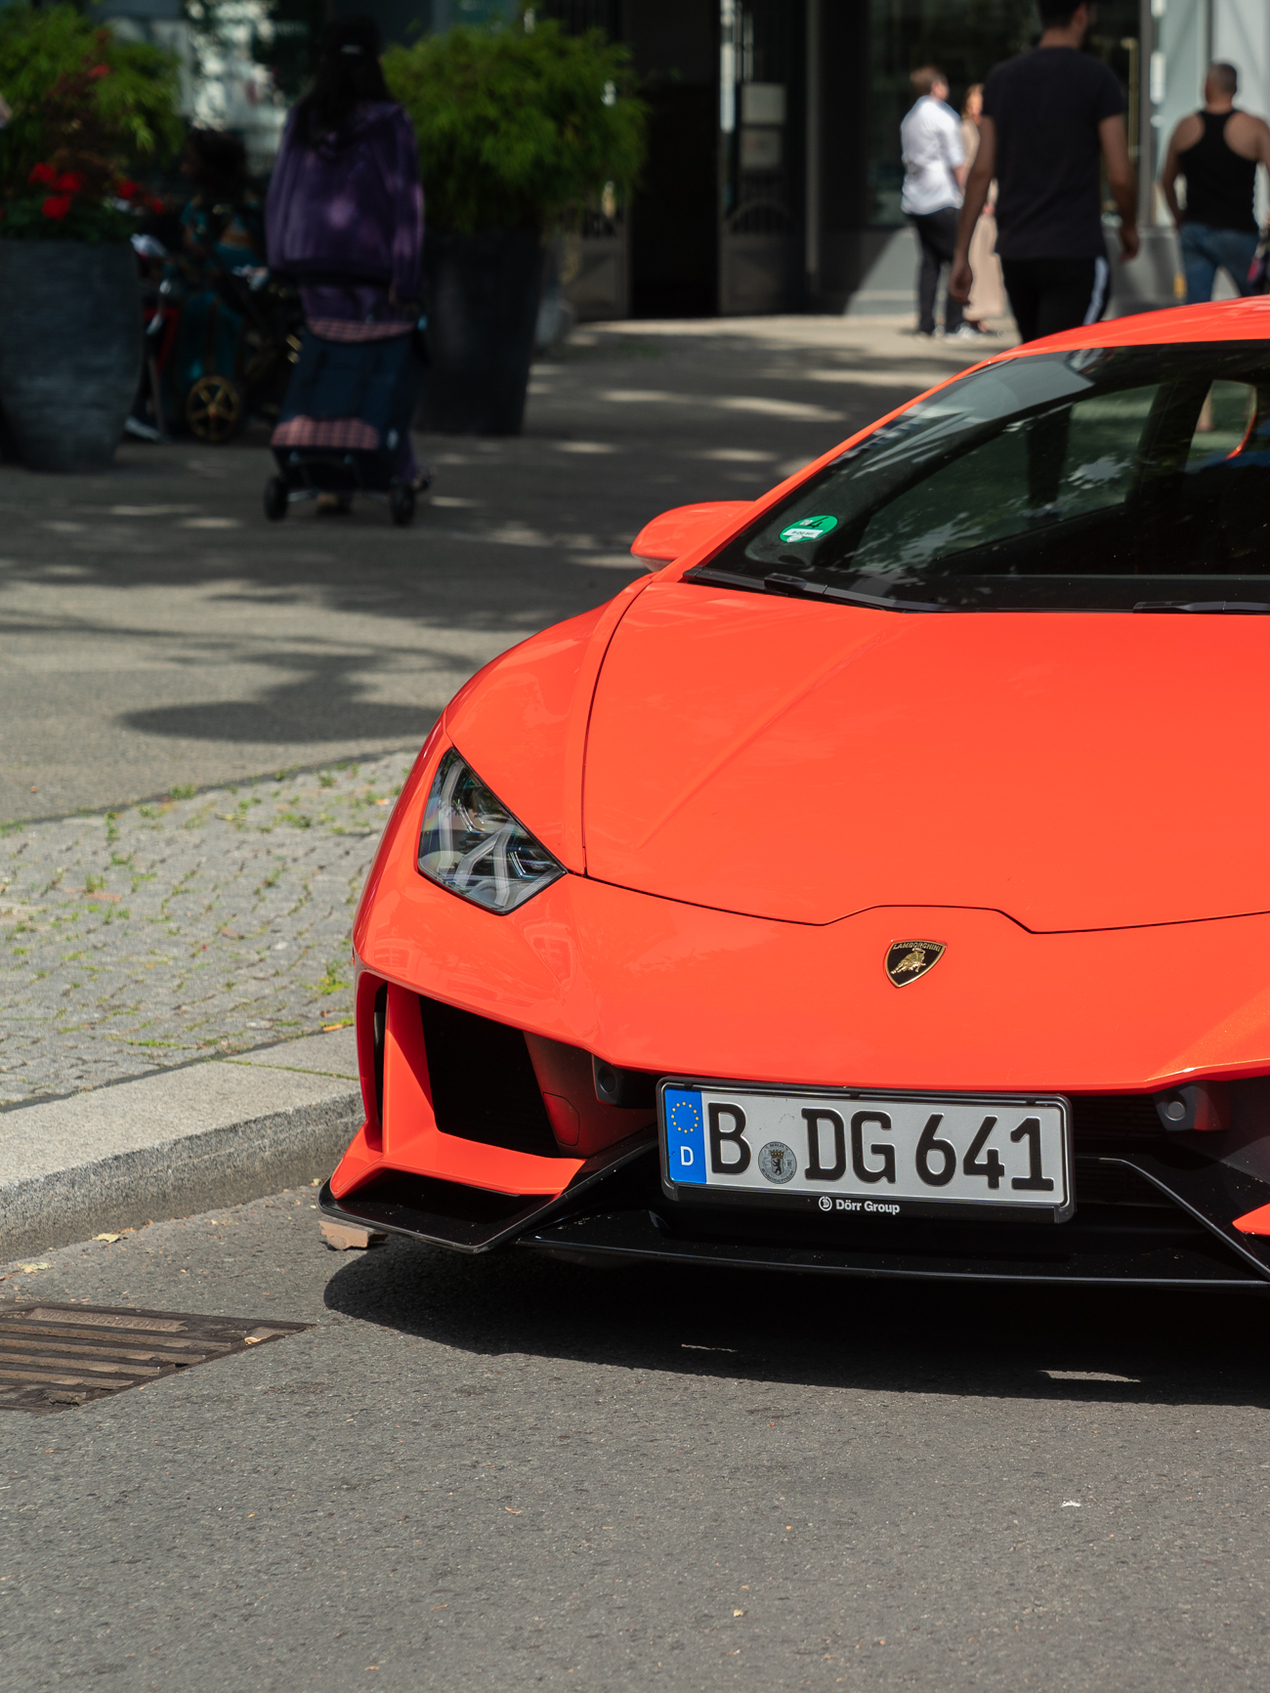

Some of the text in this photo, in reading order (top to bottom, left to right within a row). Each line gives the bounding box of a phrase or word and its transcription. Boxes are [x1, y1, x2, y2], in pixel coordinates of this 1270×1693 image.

[893, 941, 942, 952] LAMBORGHINI
[680, 1145, 694, 1166] D
[708, 1102, 1055, 1191] B DG 641
[836, 1199, 900, 1215] Dörr Group
